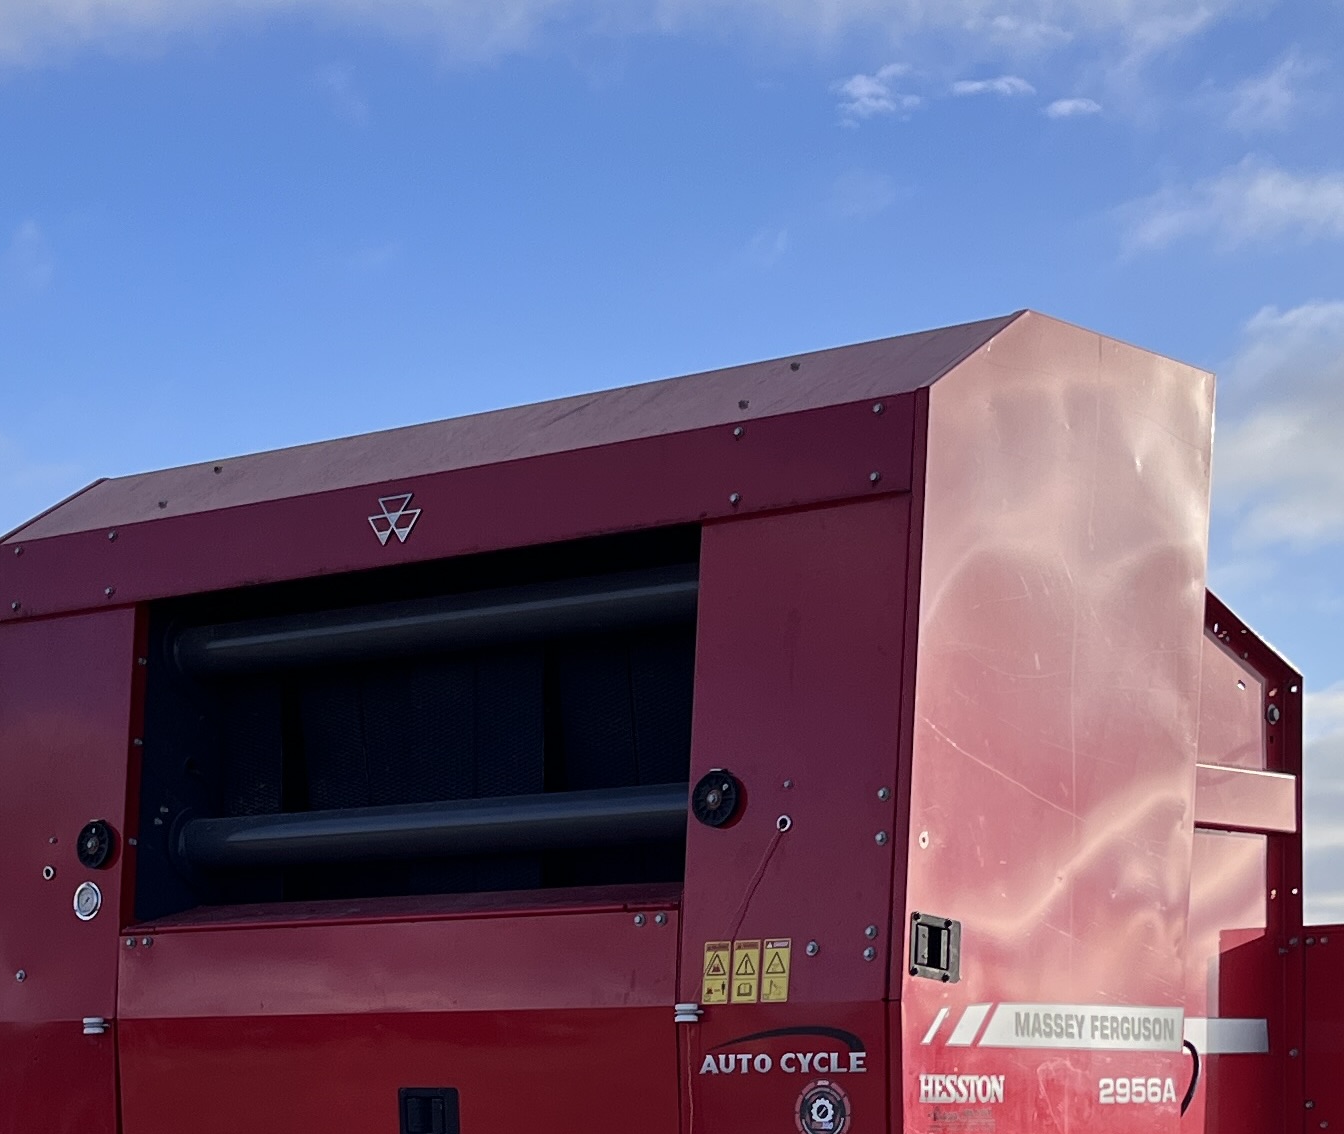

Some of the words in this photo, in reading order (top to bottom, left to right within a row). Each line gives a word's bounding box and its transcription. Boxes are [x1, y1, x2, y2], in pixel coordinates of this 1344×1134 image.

[1014, 1011, 1085, 1040] MASSEY
[1090, 1015, 1175, 1042] FERGUSON
[699, 1053, 773, 1075] AUTO
[780, 1052, 868, 1074] CYCLE
[919, 1074, 1005, 1104] HESSTON
[1098, 1077, 1177, 1105] 2956A
